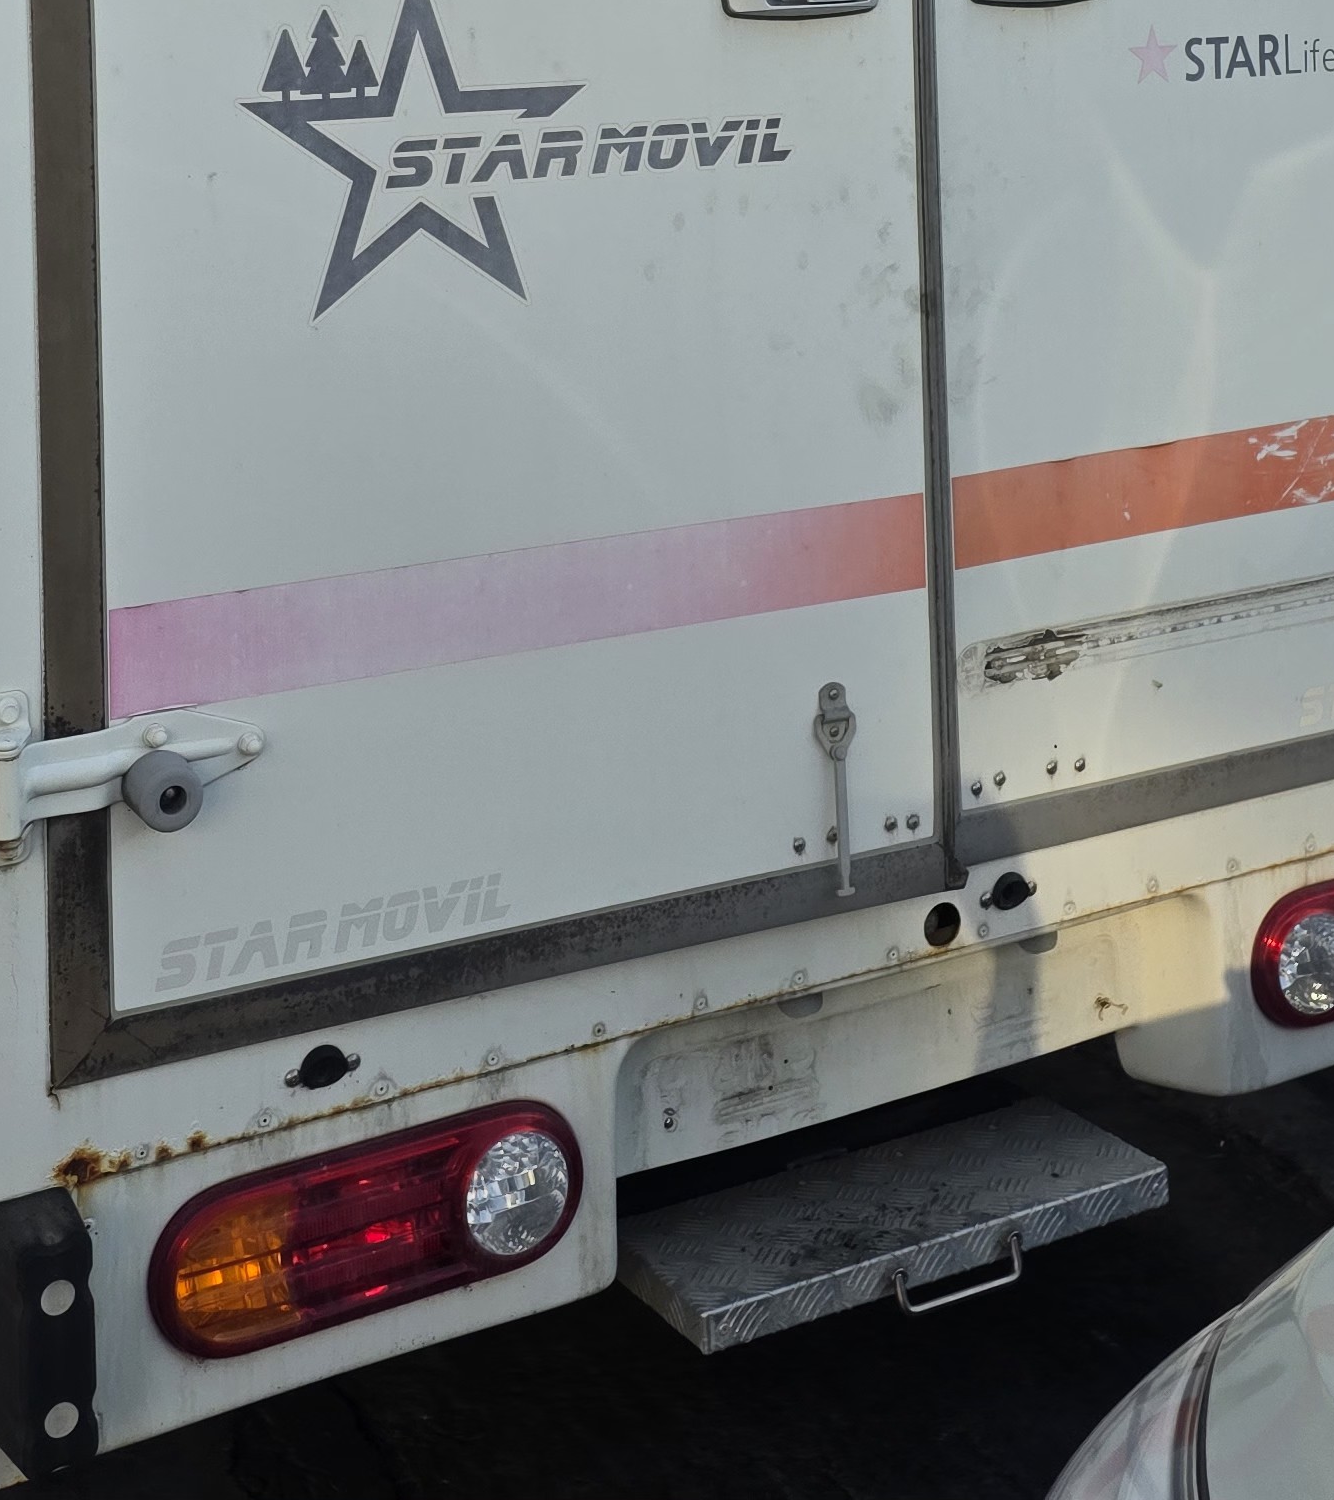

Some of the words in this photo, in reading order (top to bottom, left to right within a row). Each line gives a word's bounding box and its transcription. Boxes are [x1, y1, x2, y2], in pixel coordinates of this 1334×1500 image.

[384, 128, 584, 190] STAR
[591, 116, 792, 176] MOVIL
[155, 908, 328, 993] STAR
[334, 872, 512, 954] MOVIL
